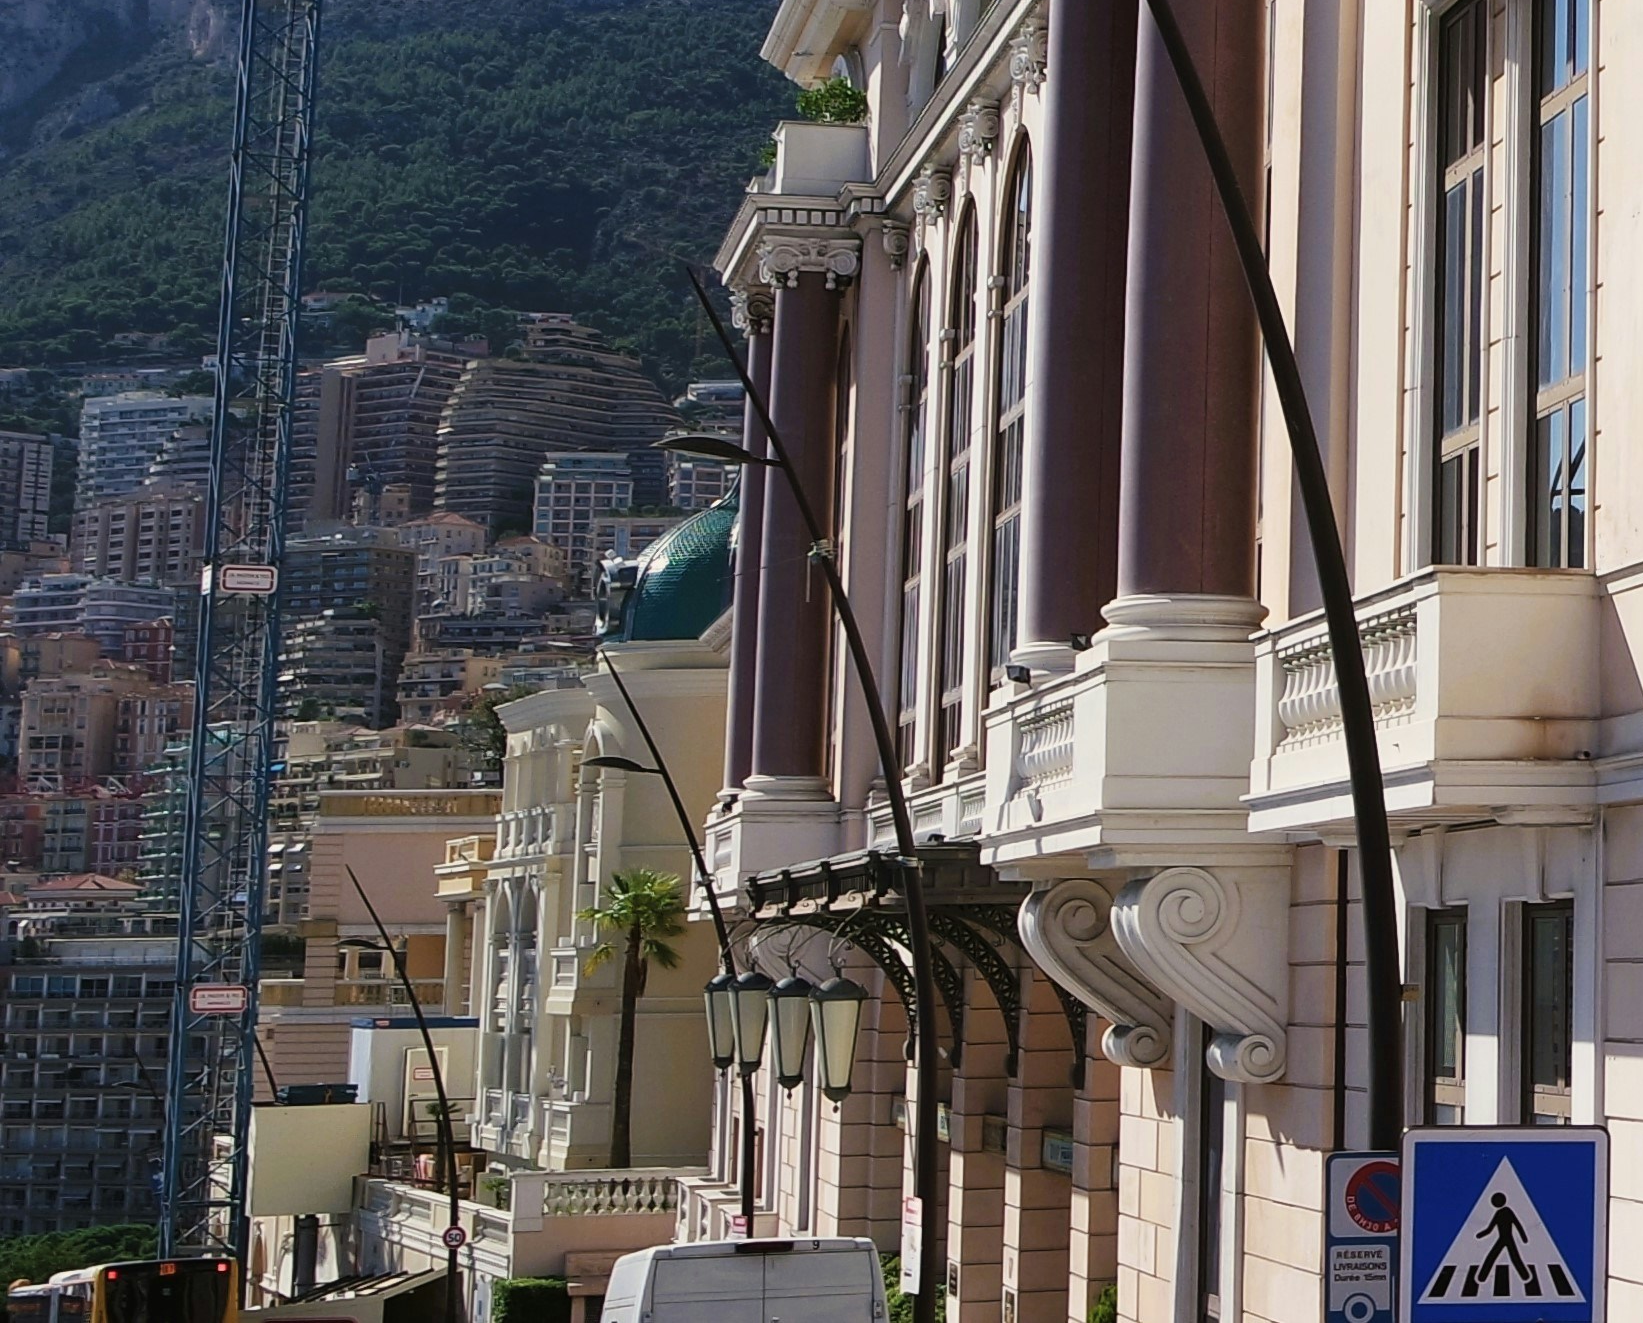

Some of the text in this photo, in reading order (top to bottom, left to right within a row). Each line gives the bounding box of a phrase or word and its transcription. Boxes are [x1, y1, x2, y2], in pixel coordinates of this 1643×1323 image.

[448, 1233, 461, 1242] 50
[813, 1240, 820, 1250] 9
[1336, 1249, 1383, 1259] RÉSERVÉ
[1333, 1262, 1387, 1271] LIVRAISONS
